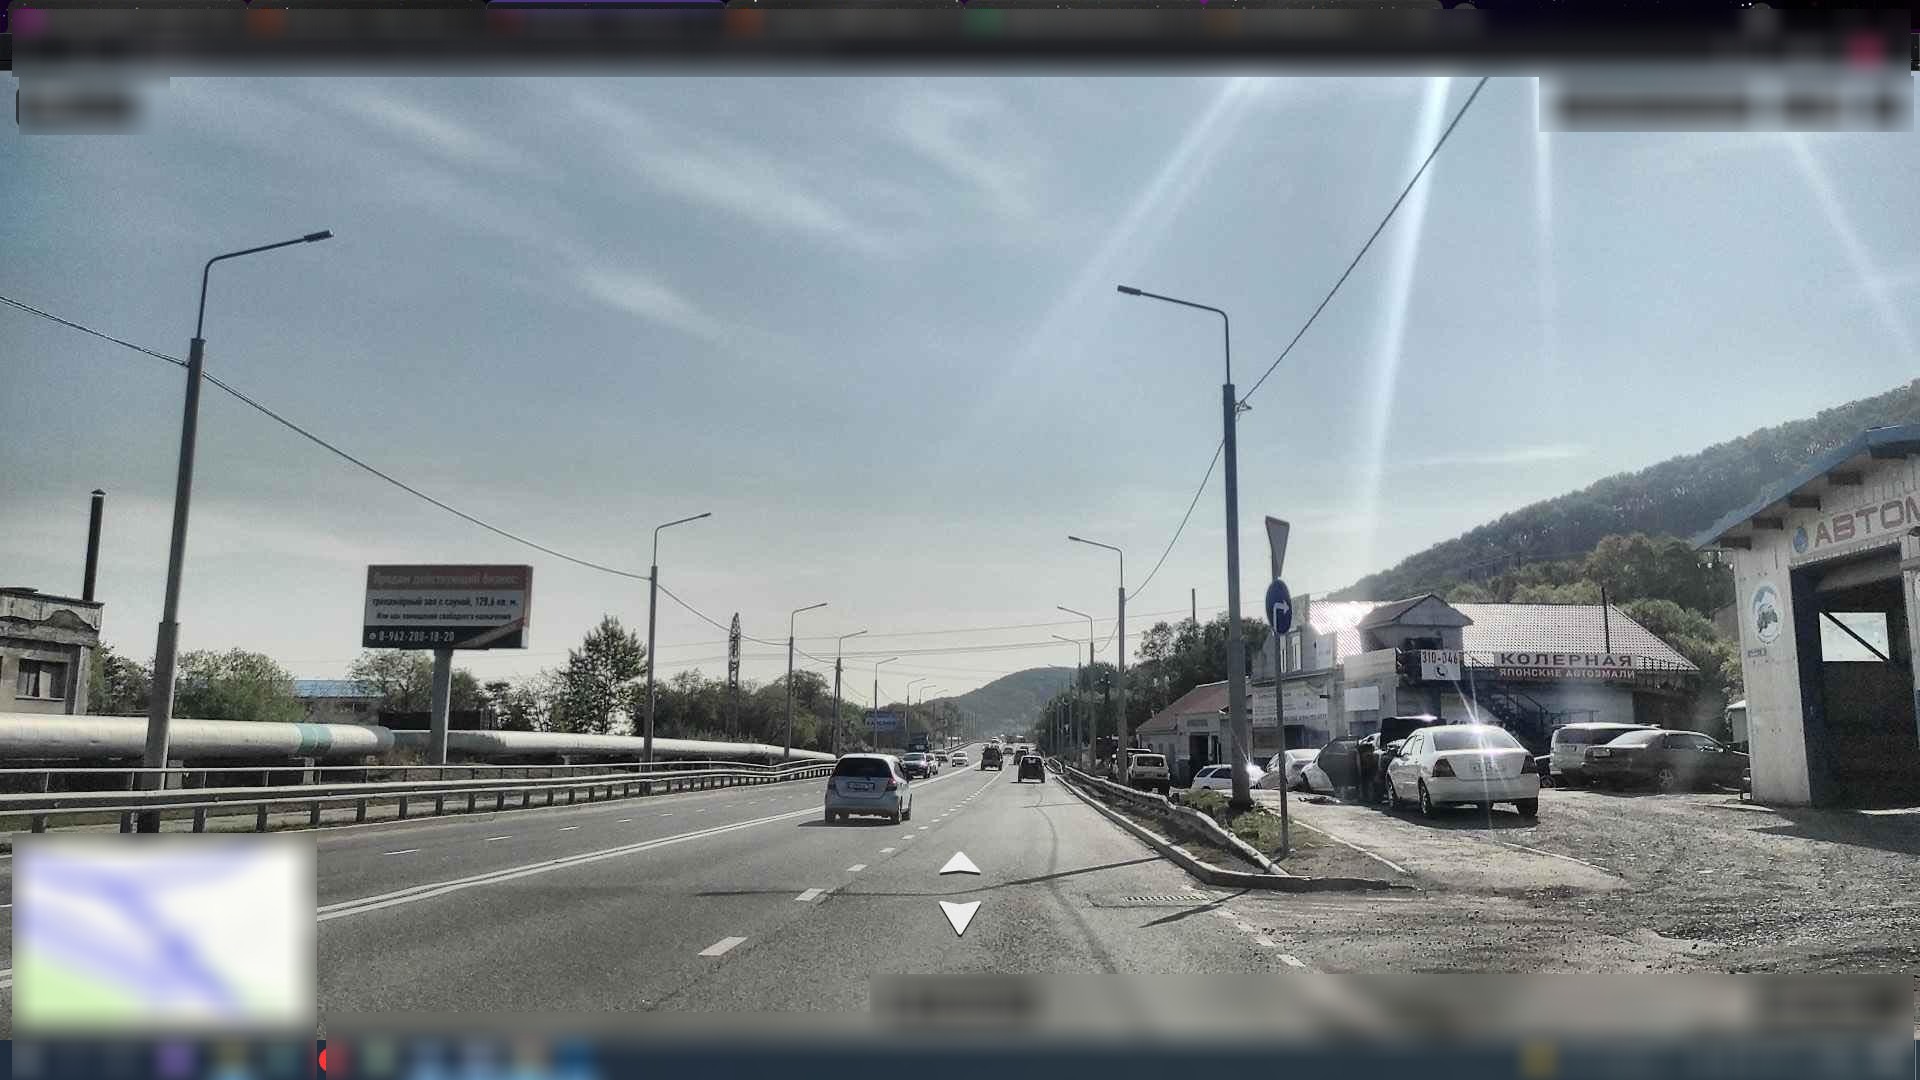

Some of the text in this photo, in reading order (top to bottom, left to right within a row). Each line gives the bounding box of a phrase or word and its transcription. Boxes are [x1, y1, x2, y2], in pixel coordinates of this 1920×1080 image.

[1500, 652, 1632, 667] КОЛЕРНАЯ
[1499, 667, 1636, 679] ЯПОНСКИЕ АВТОЭМАЛИ
